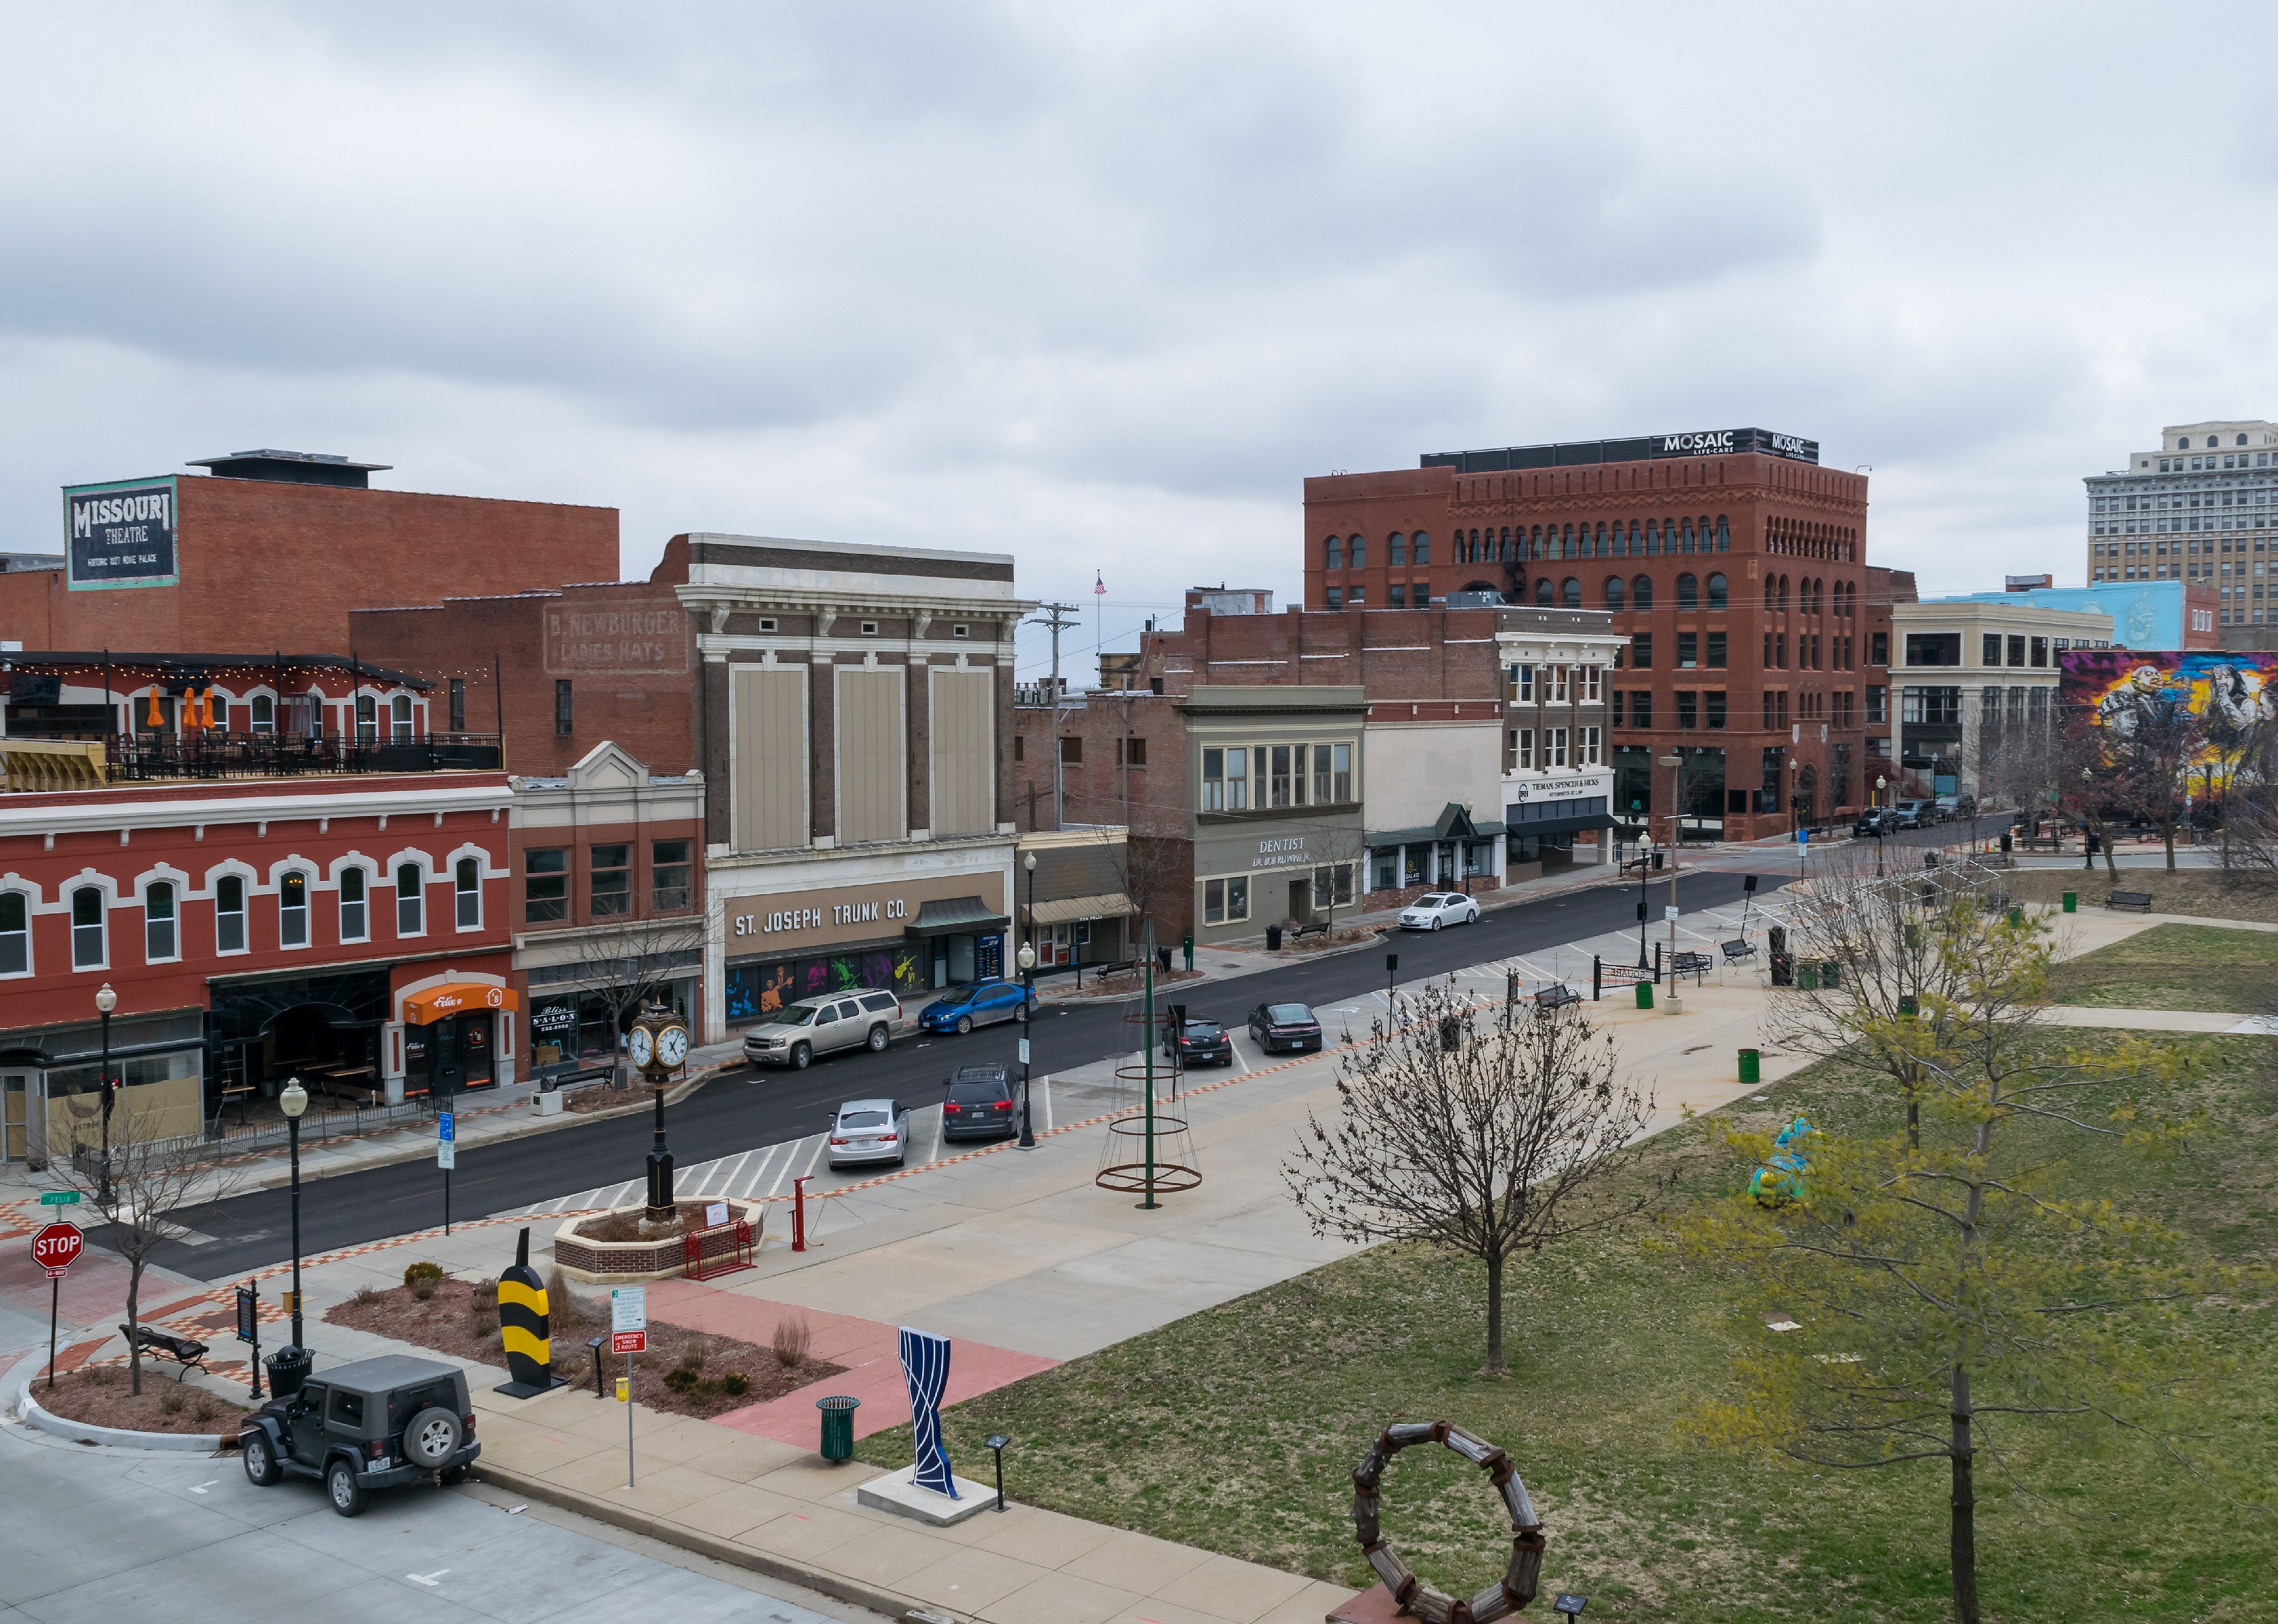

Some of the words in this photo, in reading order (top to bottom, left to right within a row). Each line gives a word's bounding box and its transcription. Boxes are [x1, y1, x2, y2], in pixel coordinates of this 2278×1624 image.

[1664, 431, 1733, 451] MOSAIC
[1772, 434, 1804, 454] MOSAIC
[74, 493, 169, 538] MISSOURI
[105, 525, 148, 545] THEATRE
[570, 611, 680, 636] NEWBURGER
[561, 643, 612, 662] LADIES
[619, 642, 665, 661] HATS
[1555, 781, 1579, 789] SPENCER
[1259, 838, 1305, 853] DENTIST
[1264, 856, 1276, 866] BOB
[736, 915, 757, 936] ST.
[763, 908, 821, 933] JOSEPH
[833, 901, 878, 925] TRUNK
[886, 899, 908, 919] CO.
[433, 995, 456, 1007] Felix
[541, 1006, 567, 1015] Bliss
[36, 1235, 80, 1256] STOP
[616, 1343, 620, 1351] 3
